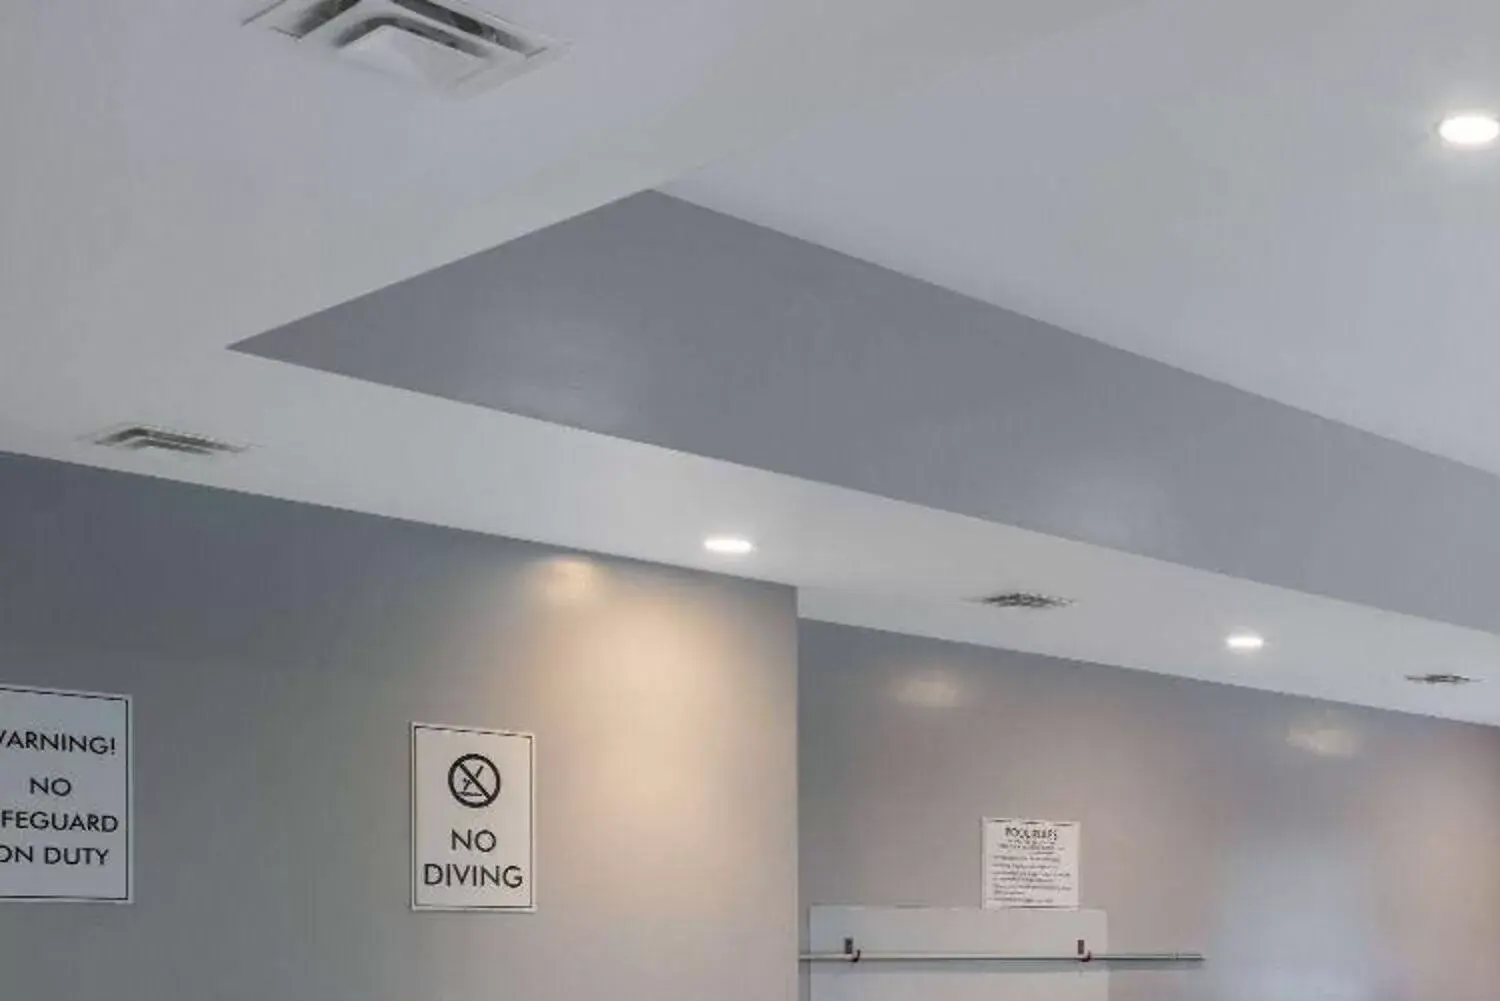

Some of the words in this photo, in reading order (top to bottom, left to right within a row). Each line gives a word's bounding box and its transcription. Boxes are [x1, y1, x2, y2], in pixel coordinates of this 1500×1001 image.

[29, 776, 72, 797] NO
[0, 809, 119, 833] FEGUARD
[450, 828, 497, 853] NO
[44, 847, 110, 866] DUTY
[423, 863, 523, 889] DIVING
